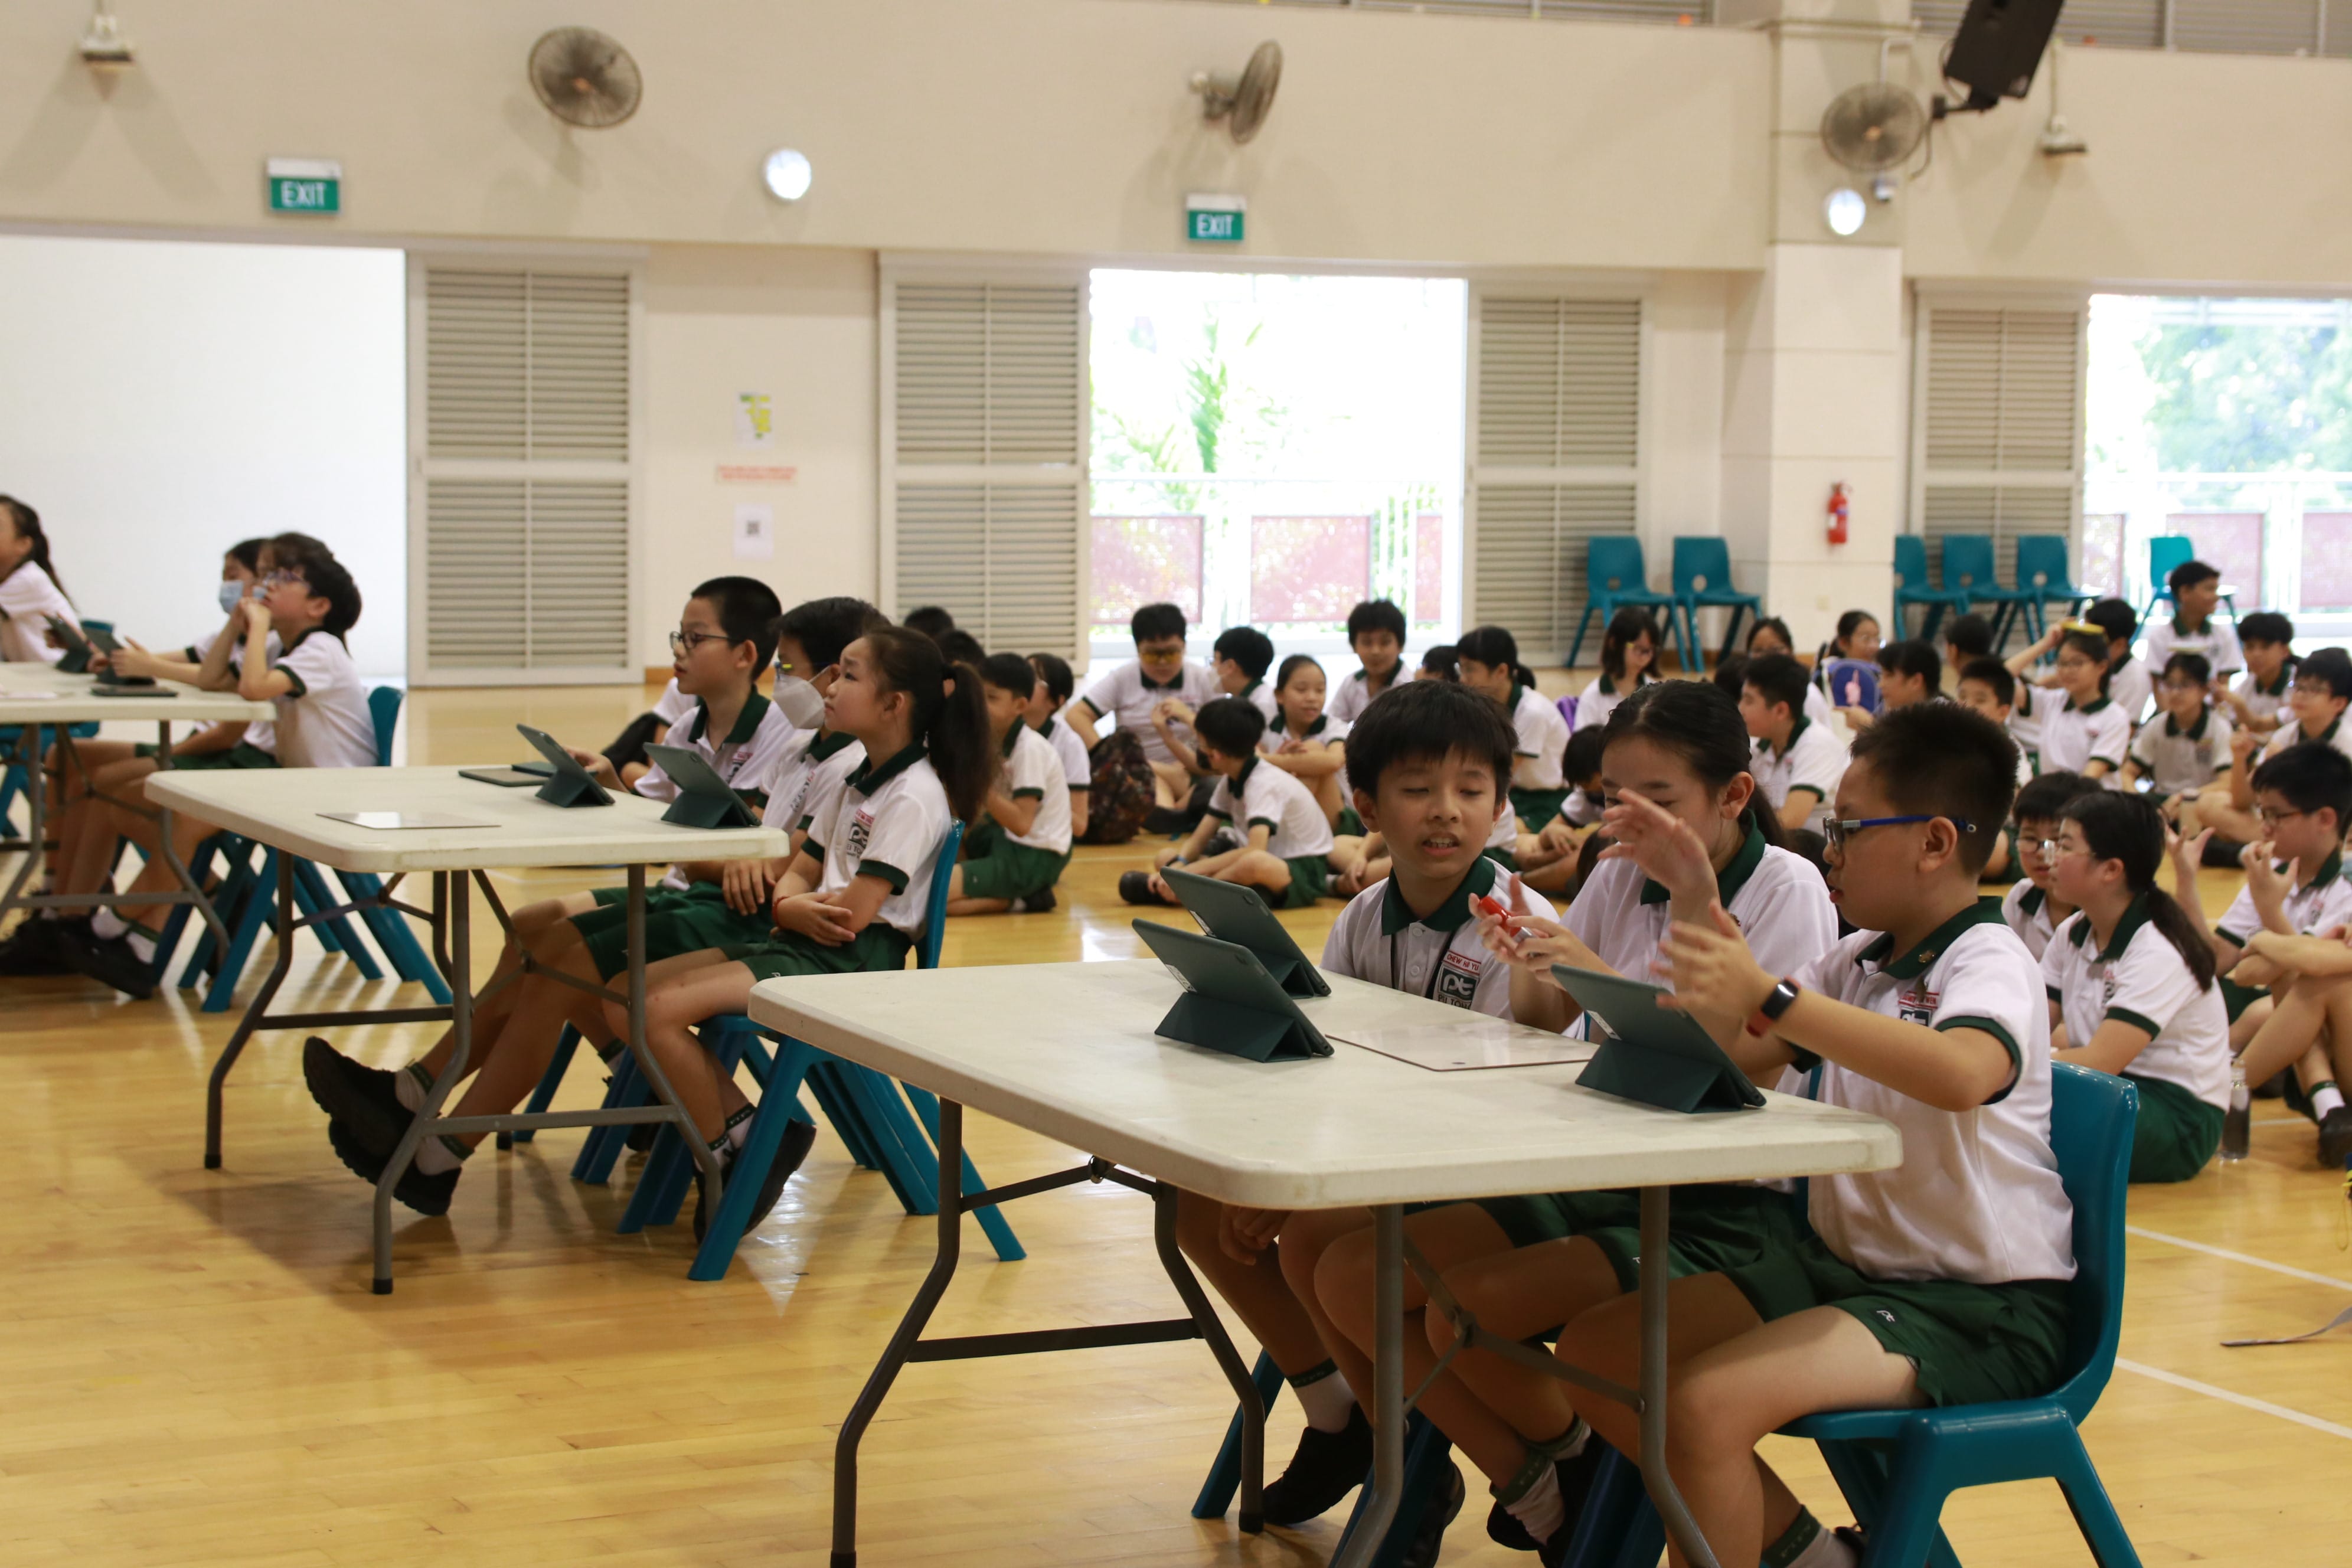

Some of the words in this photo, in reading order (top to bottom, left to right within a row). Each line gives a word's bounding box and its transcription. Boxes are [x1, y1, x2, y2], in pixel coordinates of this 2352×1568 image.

[281, 181, 326, 207] EXIT
[1197, 214, 1234, 237] EXIT
[1447, 953, 1462, 964] CHEW
